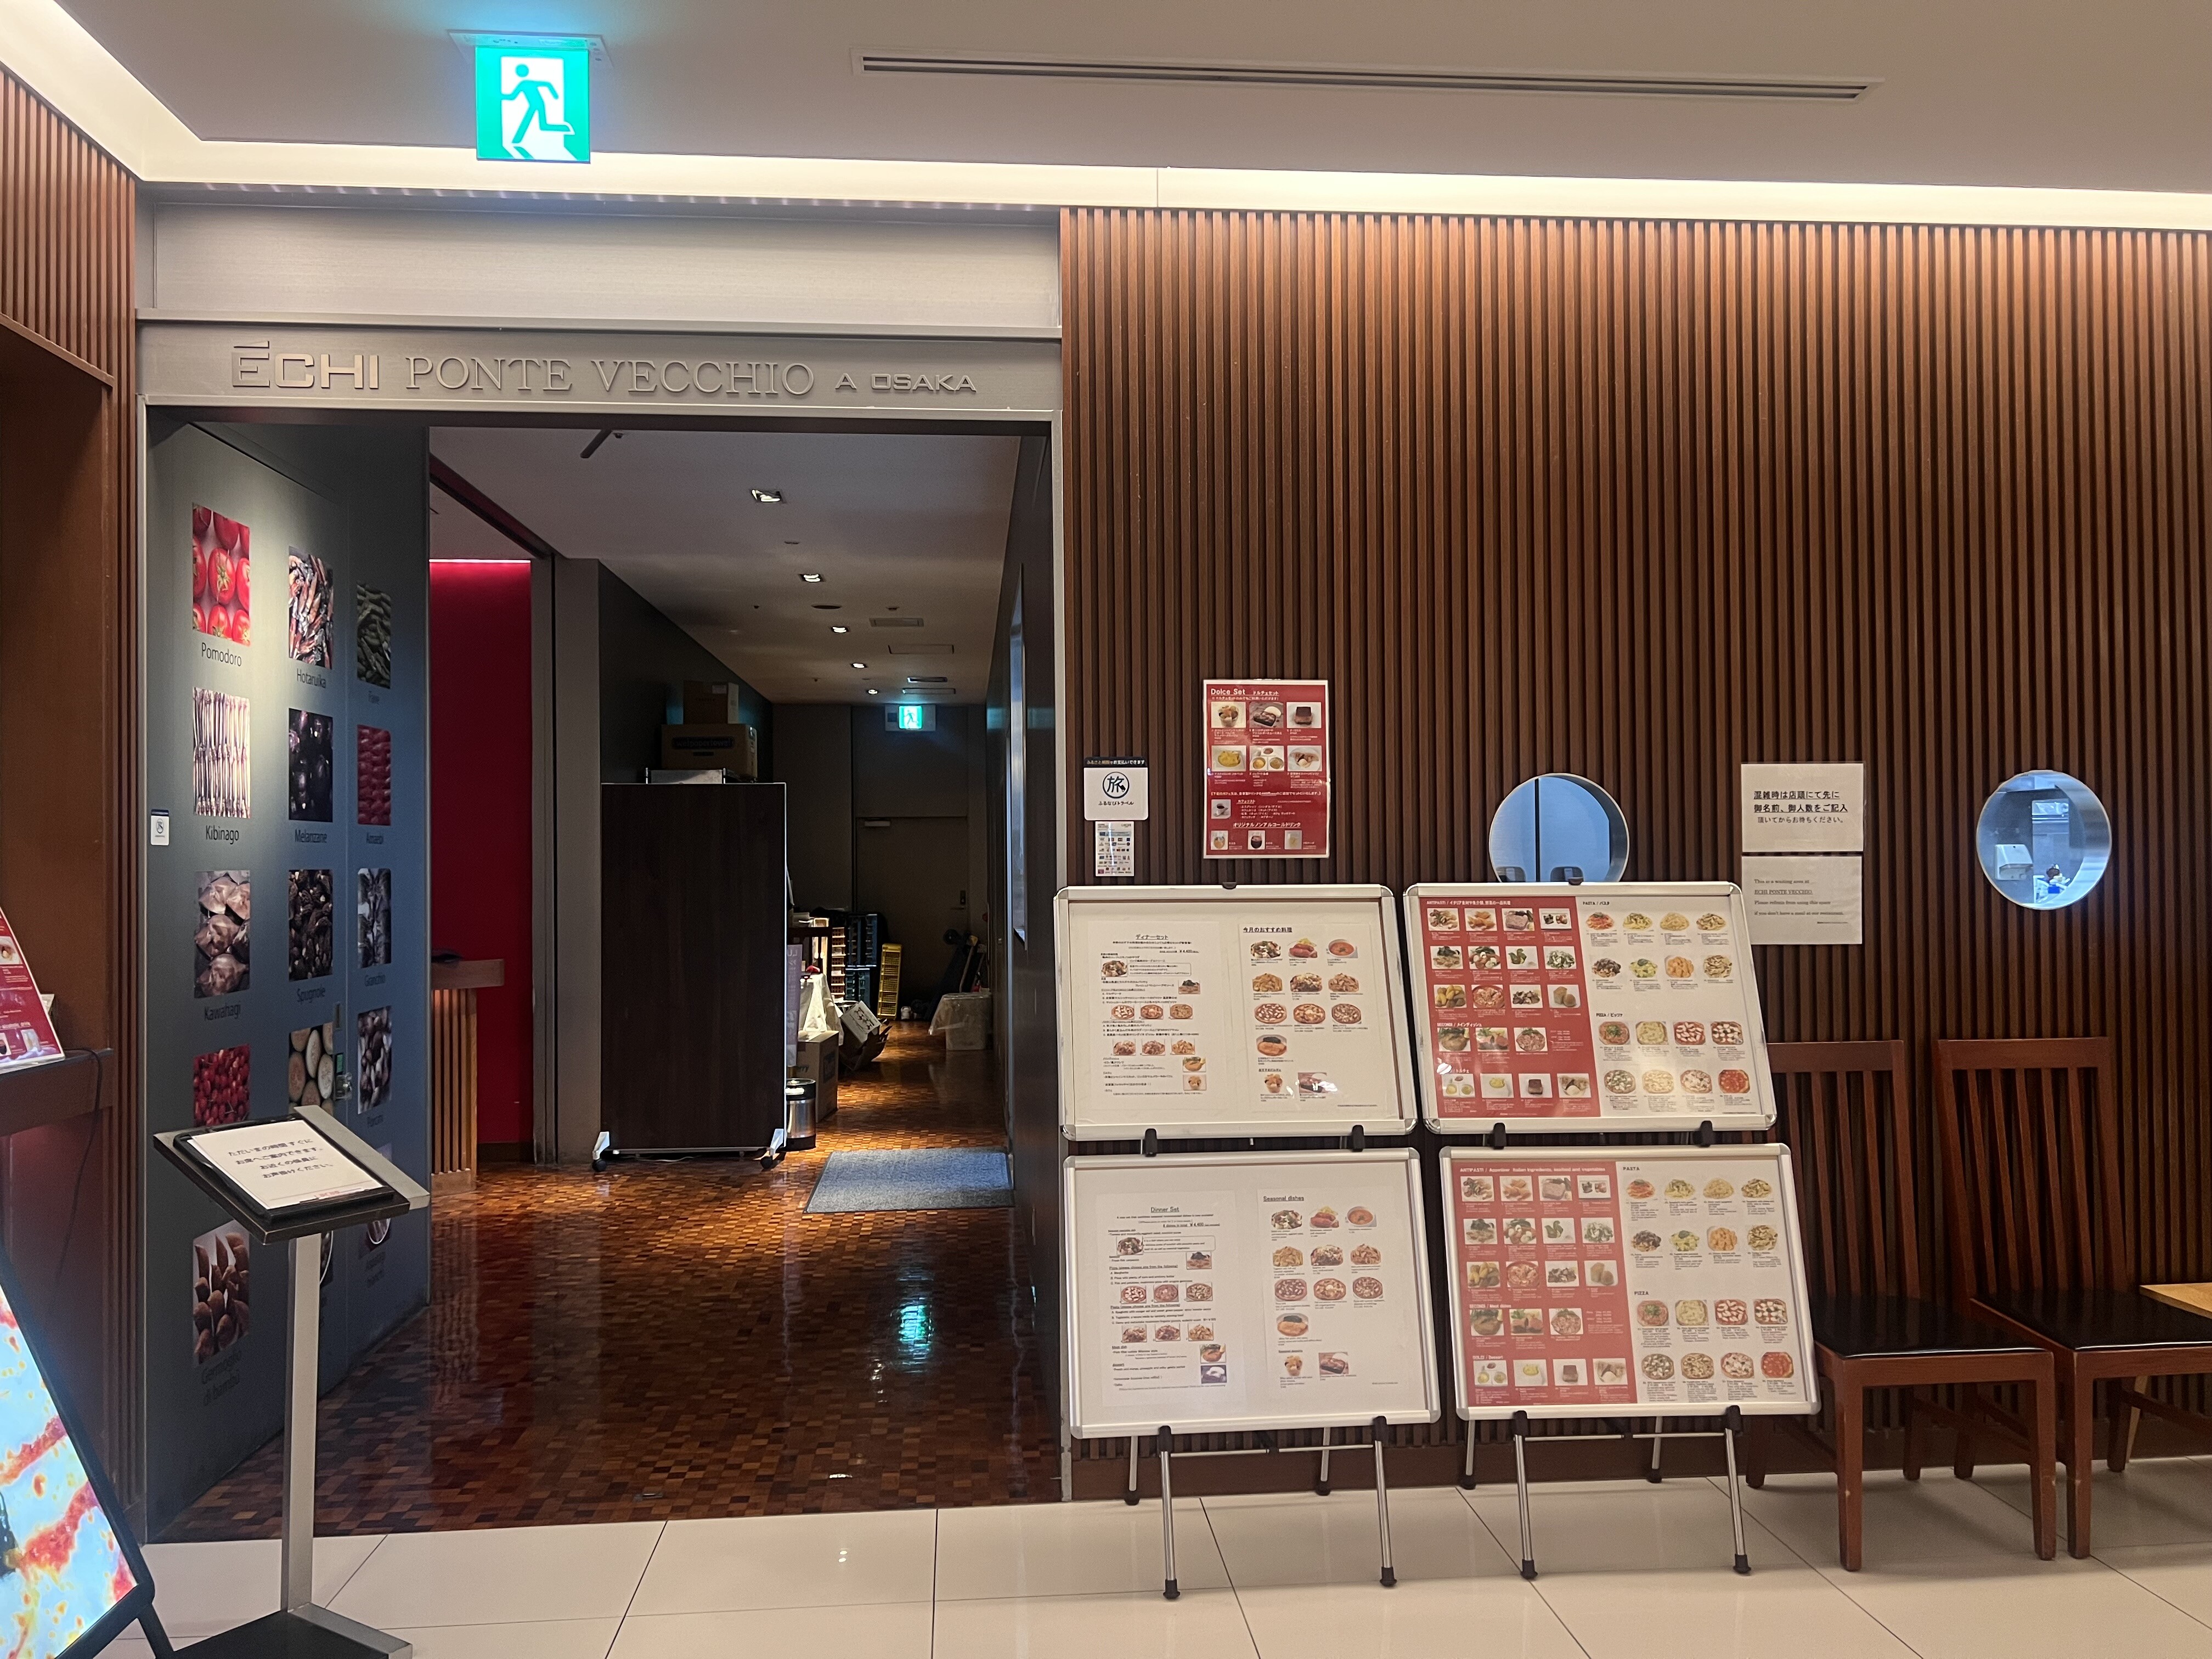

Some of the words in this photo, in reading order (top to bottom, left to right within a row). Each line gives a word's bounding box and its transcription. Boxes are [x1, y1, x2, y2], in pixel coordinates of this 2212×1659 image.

[405, 357, 573, 392] PONTE
[590, 360, 815, 396] VECCHIO
[835, 372, 857, 391] A
[871, 373, 977, 393] OSAKA
[201, 642, 242, 667] Pomodoro
[296, 668, 326, 689] Hotaruika
[1754, 791, 1839, 799] 混雑時は店頭にて先に
[1754, 804, 1848, 812] 御名前、御人数をご記入
[205, 825, 239, 844] Kibinago
[204, 1001, 241, 1022] Kawahagi
